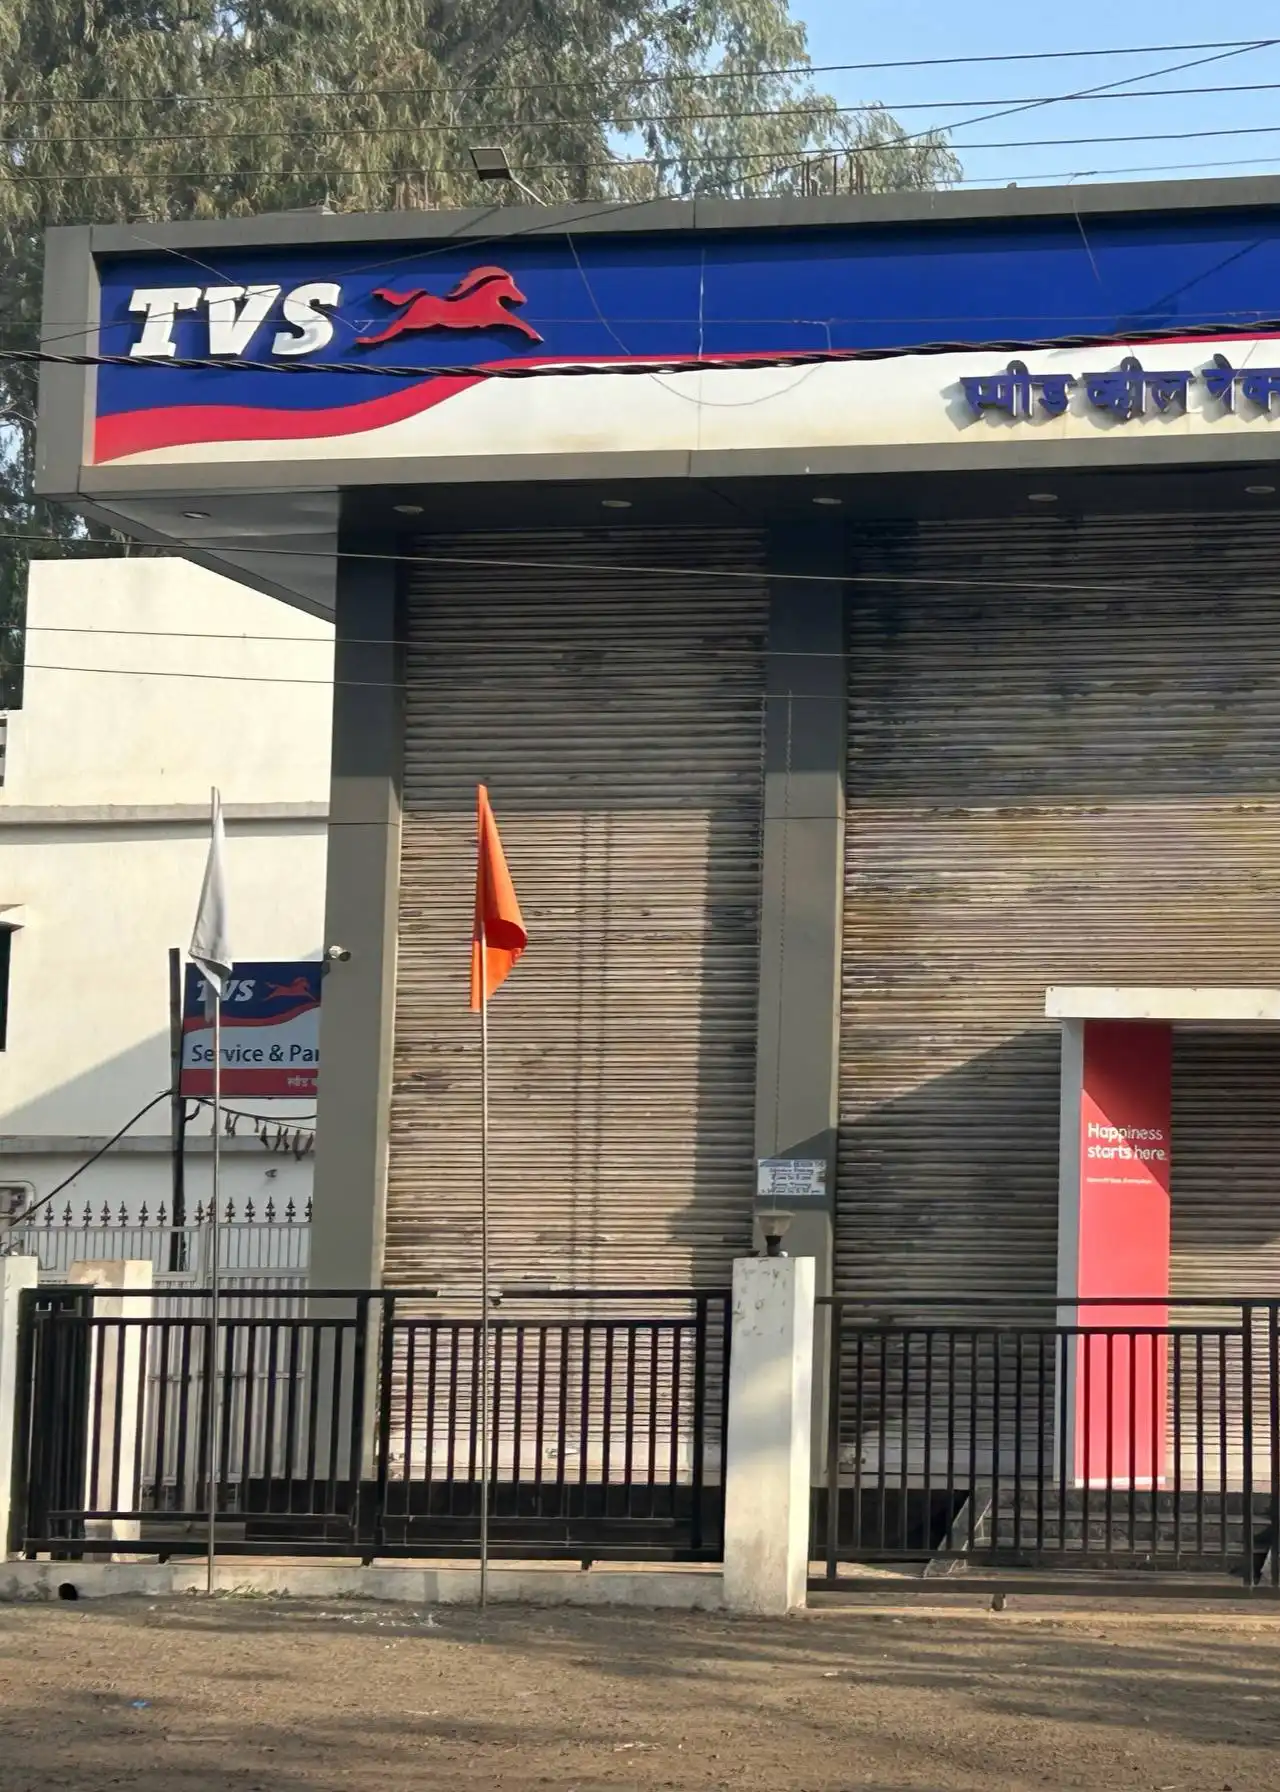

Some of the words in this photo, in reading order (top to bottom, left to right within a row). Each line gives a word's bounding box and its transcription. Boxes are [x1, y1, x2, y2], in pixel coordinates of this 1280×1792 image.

[128, 282, 341, 358] TVS
[959, 359, 1076, 419] स्पीड
[1082, 356, 1194, 421] व्हील
[269, 1043, 284, 1062] &
[1087, 1122, 1164, 1142] Happiness
[1087, 1144, 1132, 1160] starts
